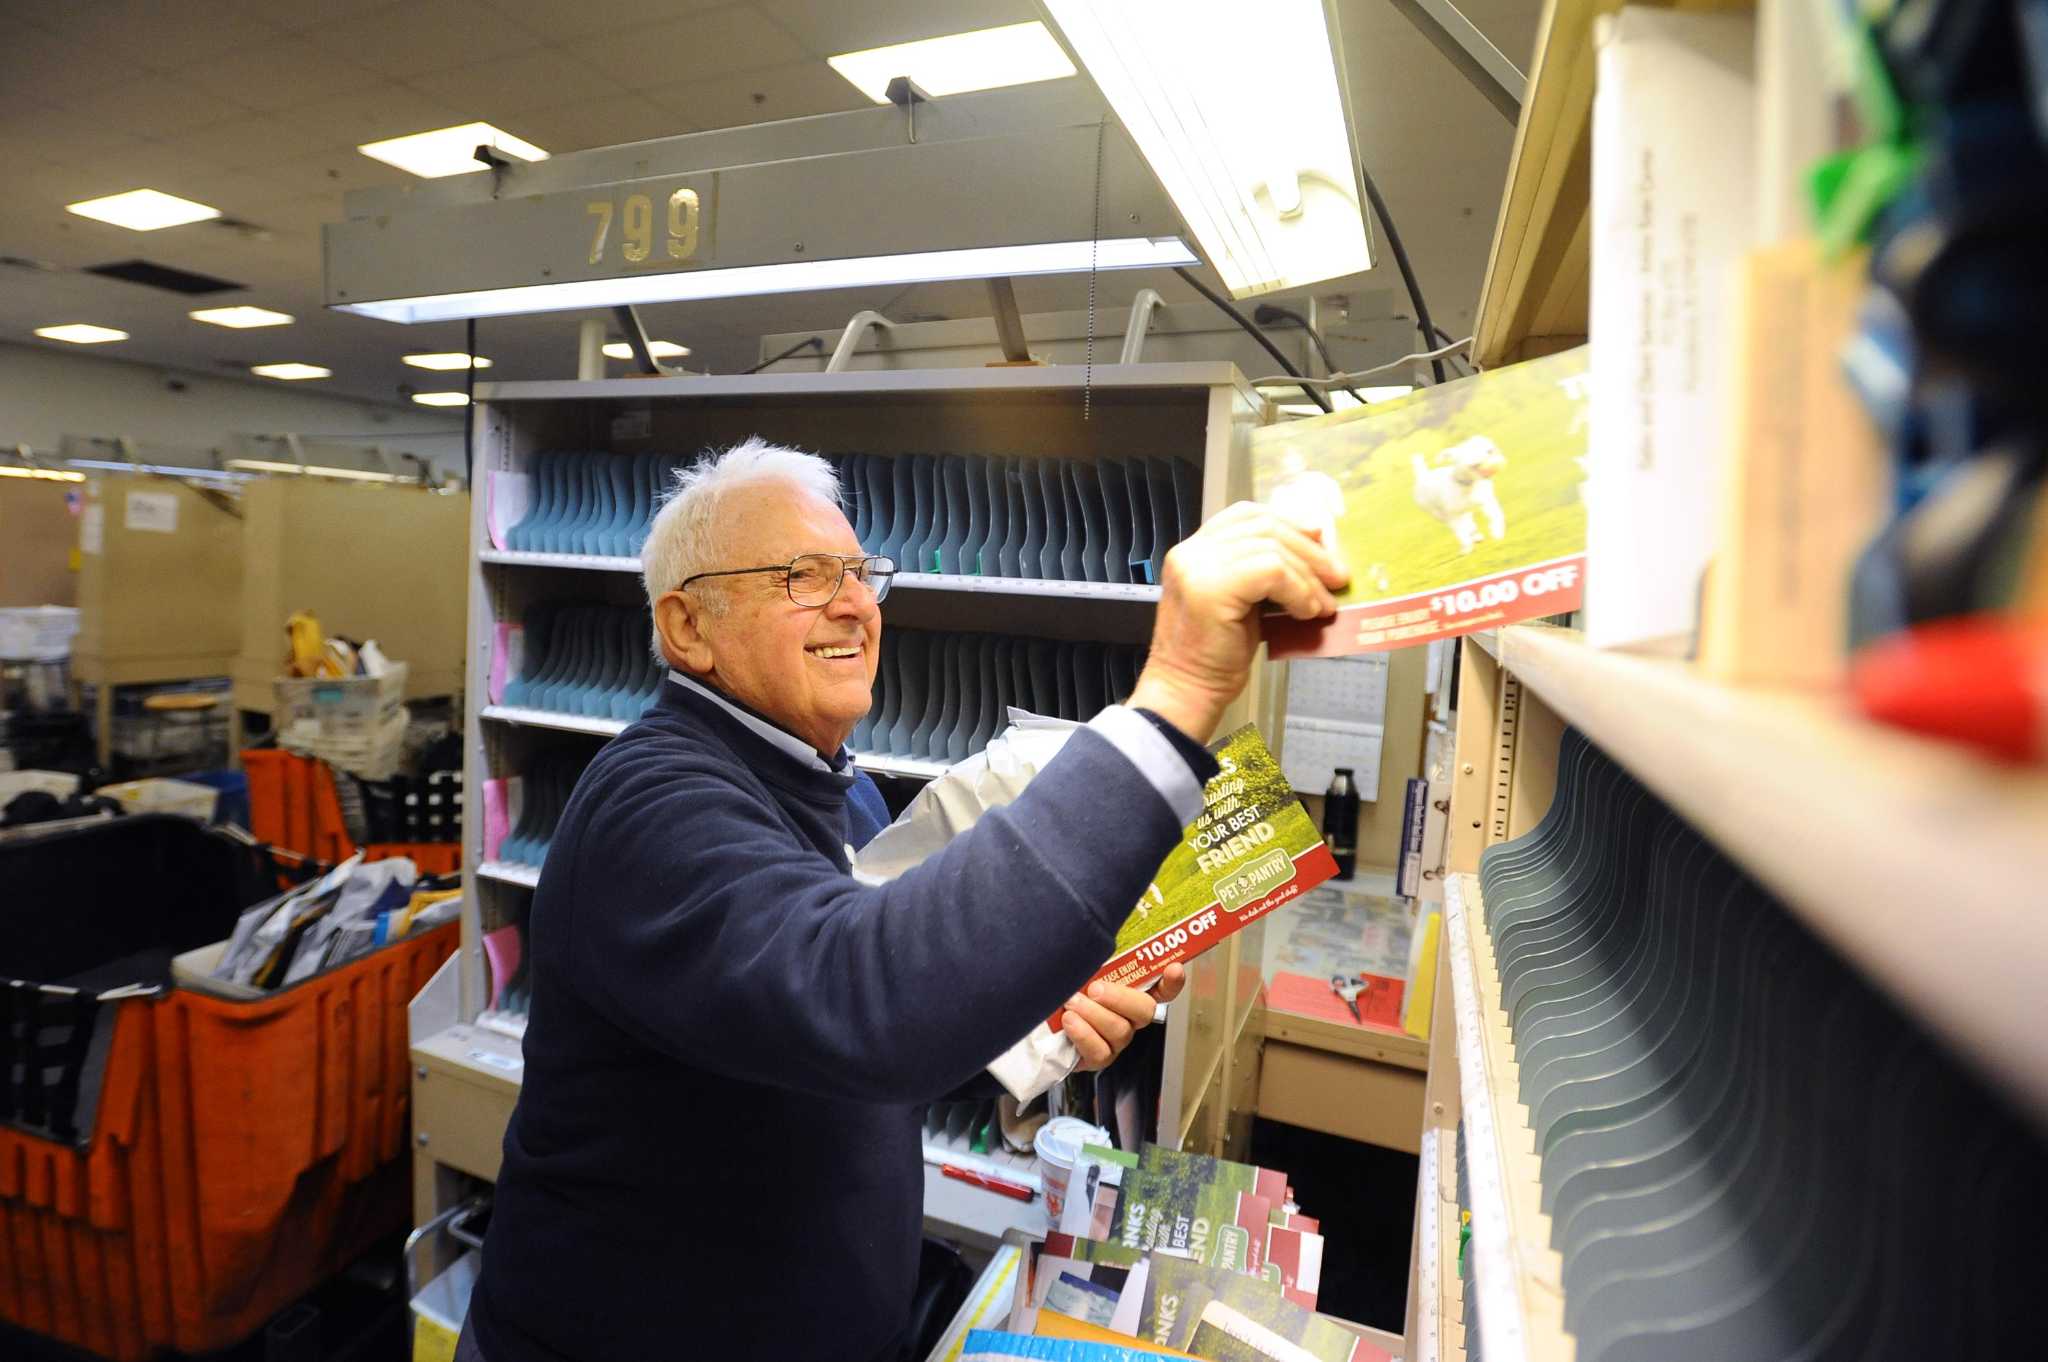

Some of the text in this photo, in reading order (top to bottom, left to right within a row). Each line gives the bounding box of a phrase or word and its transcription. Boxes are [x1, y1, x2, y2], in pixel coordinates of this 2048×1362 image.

[585, 188, 700, 265] 799
[1430, 565, 1578, 616] $10.00 OFF
[1187, 804, 1261, 853] YOUR BEST
[1196, 794, 1241, 830] us with
[1196, 821, 1275, 875] FRIEND
[1218, 854, 1287, 903] PET PANTRY
[1135, 910, 1218, 961] $10.00 OFF
[1119, 959, 1139, 979] ENJOY
[1172, 1215, 1190, 1249] BEST
